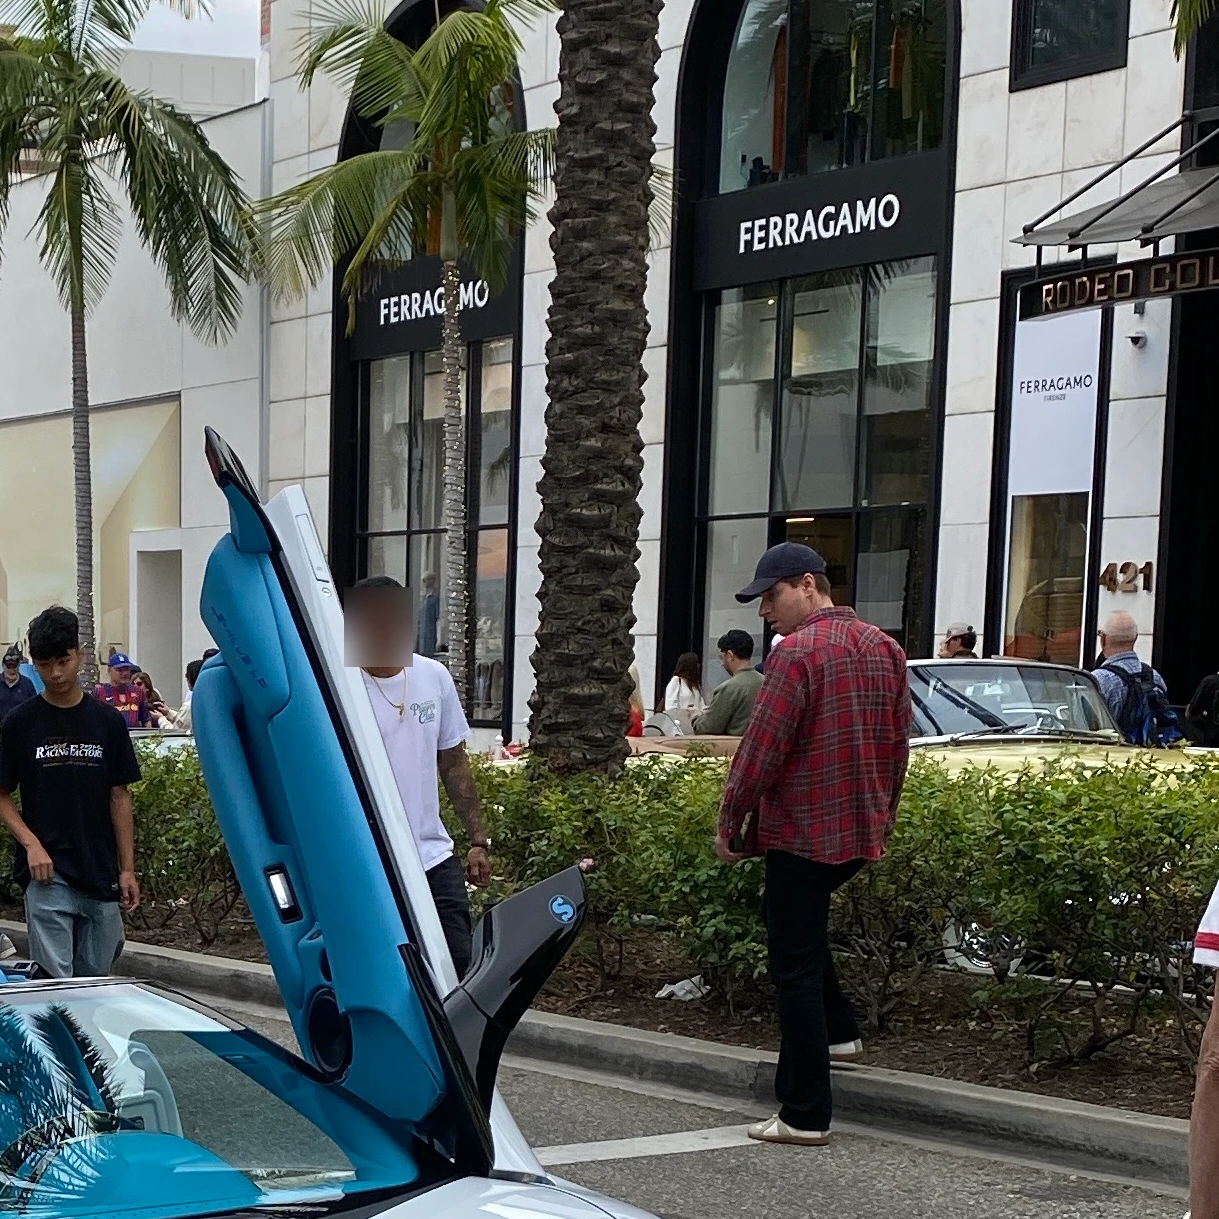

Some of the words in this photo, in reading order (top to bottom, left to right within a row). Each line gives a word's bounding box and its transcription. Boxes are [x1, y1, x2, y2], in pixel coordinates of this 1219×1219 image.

[738, 193, 900, 254] FERRAGAMO
[379, 279, 490, 325] FERRAGMO
[1042, 269, 1133, 312] RODEO
[1150, 255, 1219, 292] COL
[1019, 374, 1093, 395] FERRAGAMO
[1099, 561, 1153, 593] 421
